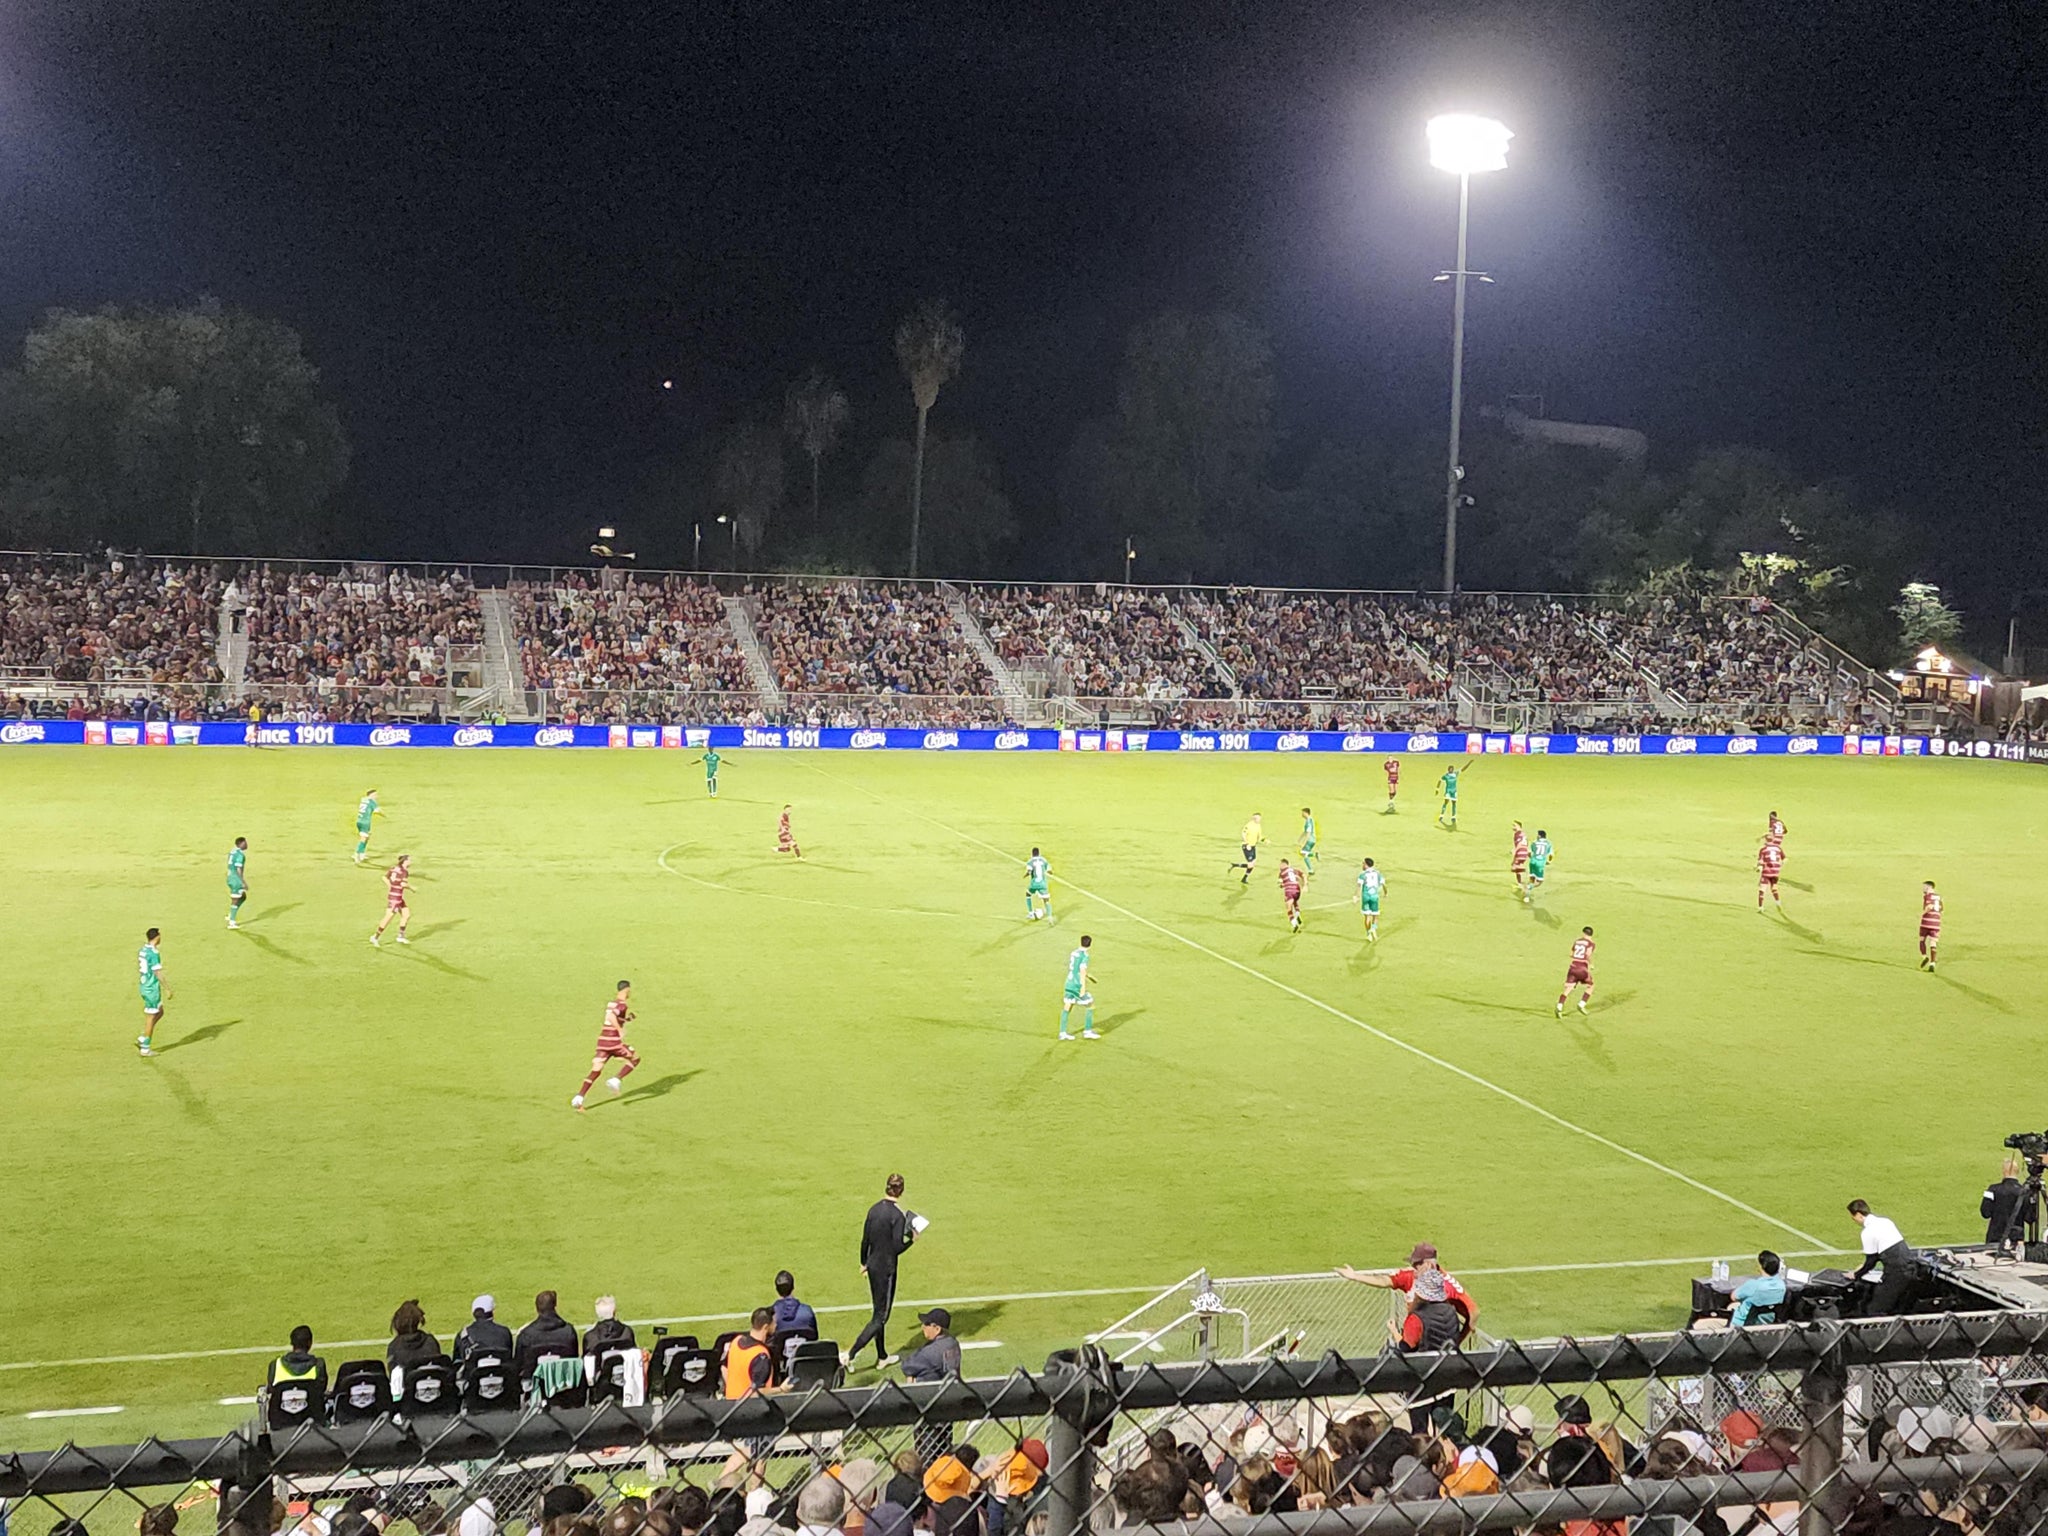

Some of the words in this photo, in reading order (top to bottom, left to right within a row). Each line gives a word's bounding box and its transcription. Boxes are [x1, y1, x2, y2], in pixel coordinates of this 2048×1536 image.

[295, 725, 335, 744] 1901
[743, 729, 782, 747] Since
[786, 729, 820, 747] 1901
[1180, 733, 1215, 750] Since
[1219, 733, 1250, 750] 1901
[1576, 737, 1609, 753] Since
[1612, 737, 1641, 753] 1901
[1948, 740, 1973, 757] 0-1
[1993, 743, 2025, 761] 71:11
[1573, 944, 1586, 959] 22
